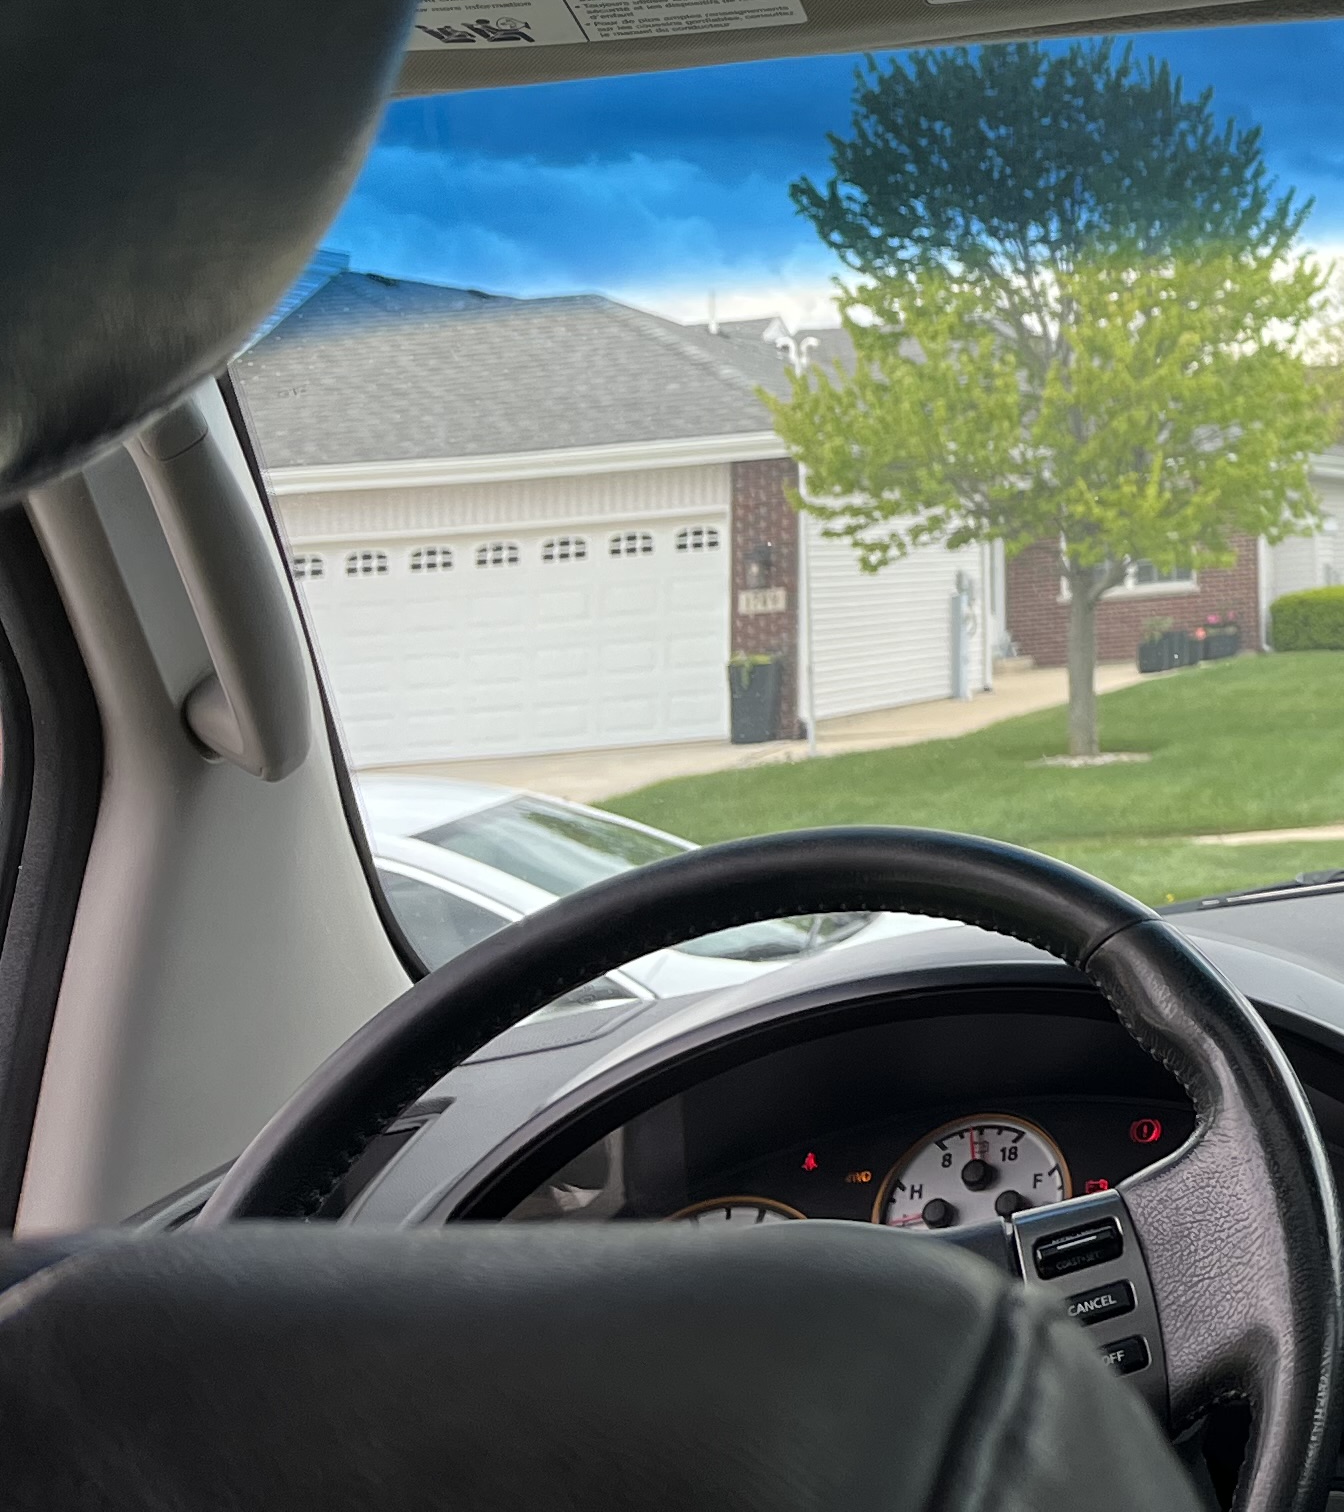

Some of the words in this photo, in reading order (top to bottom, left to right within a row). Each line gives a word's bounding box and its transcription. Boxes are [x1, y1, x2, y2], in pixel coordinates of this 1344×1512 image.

[941, 1154, 952, 1169] 8
[1000, 1146, 1018, 1162] 18
[1033, 1174, 1043, 1189] F
[909, 1184, 923, 1200] H
[1067, 1294, 1117, 1317] CANCEL
